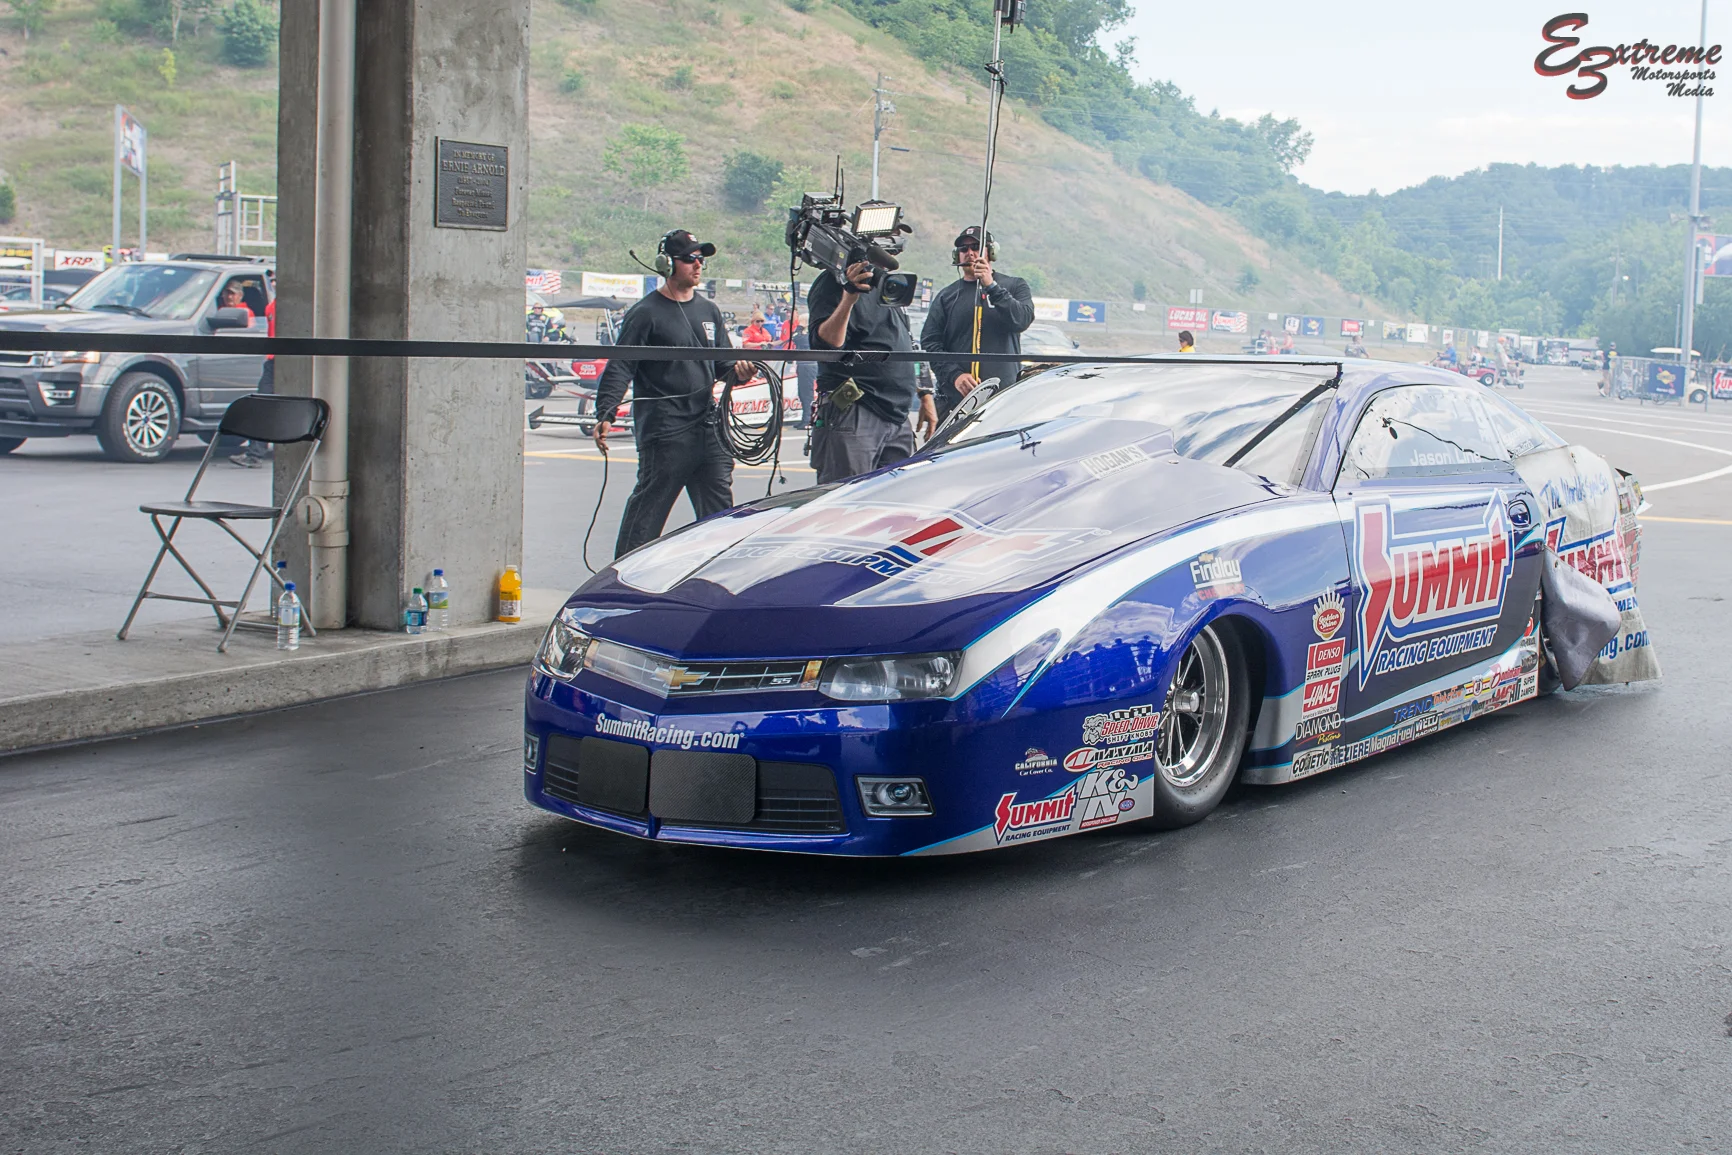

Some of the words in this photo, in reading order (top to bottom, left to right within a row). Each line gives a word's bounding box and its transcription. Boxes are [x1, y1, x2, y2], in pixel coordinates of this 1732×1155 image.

[442, 160, 469, 173] ERNIE
[471, 163, 506, 176] ARNOLD
[60, 256, 93, 266] XRP
[1169, 310, 1195, 321] LUCAS
[1196, 312, 1207, 322] OIL
[1083, 446, 1144, 475] HOGAN'S
[1410, 449, 1454, 466] Jason
[1190, 556, 1241, 583] Findlay
[1357, 498, 1510, 670] SUMMIT
[1319, 613, 1340, 625] Golden
[1320, 620, 1338, 630] Shine
[1318, 646, 1341, 662] DENSO
[1376, 646, 1429, 675] RACING
[1428, 624, 1498, 662] EQUIPMENT
[1306, 669, 1324, 681] SPARK
[1324, 664, 1342, 675] PLUGS
[1523, 675, 1535, 686] SUPER
[1305, 681, 1339, 708] HAAS
[1520, 685, 1535, 698] DAMPER
[1394, 698, 1432, 724] TREND
[595, 713, 741, 750] SummitRacing.com
[1101, 719, 1129, 736] SPEED
[1131, 713, 1159, 731] DAWG
[1296, 712, 1341, 741] DIAMOND
[1106, 734, 1128, 745] SHIFT
[1129, 730, 1154, 741] KNOBS
[1330, 739, 1370, 766] MEZIERE
[1015, 758, 1058, 771] CALIFORNIA
[996, 787, 1076, 843] SUMMIT
[1005, 830, 1031, 842] RACING
[1032, 824, 1071, 837] EQUIPMENT
